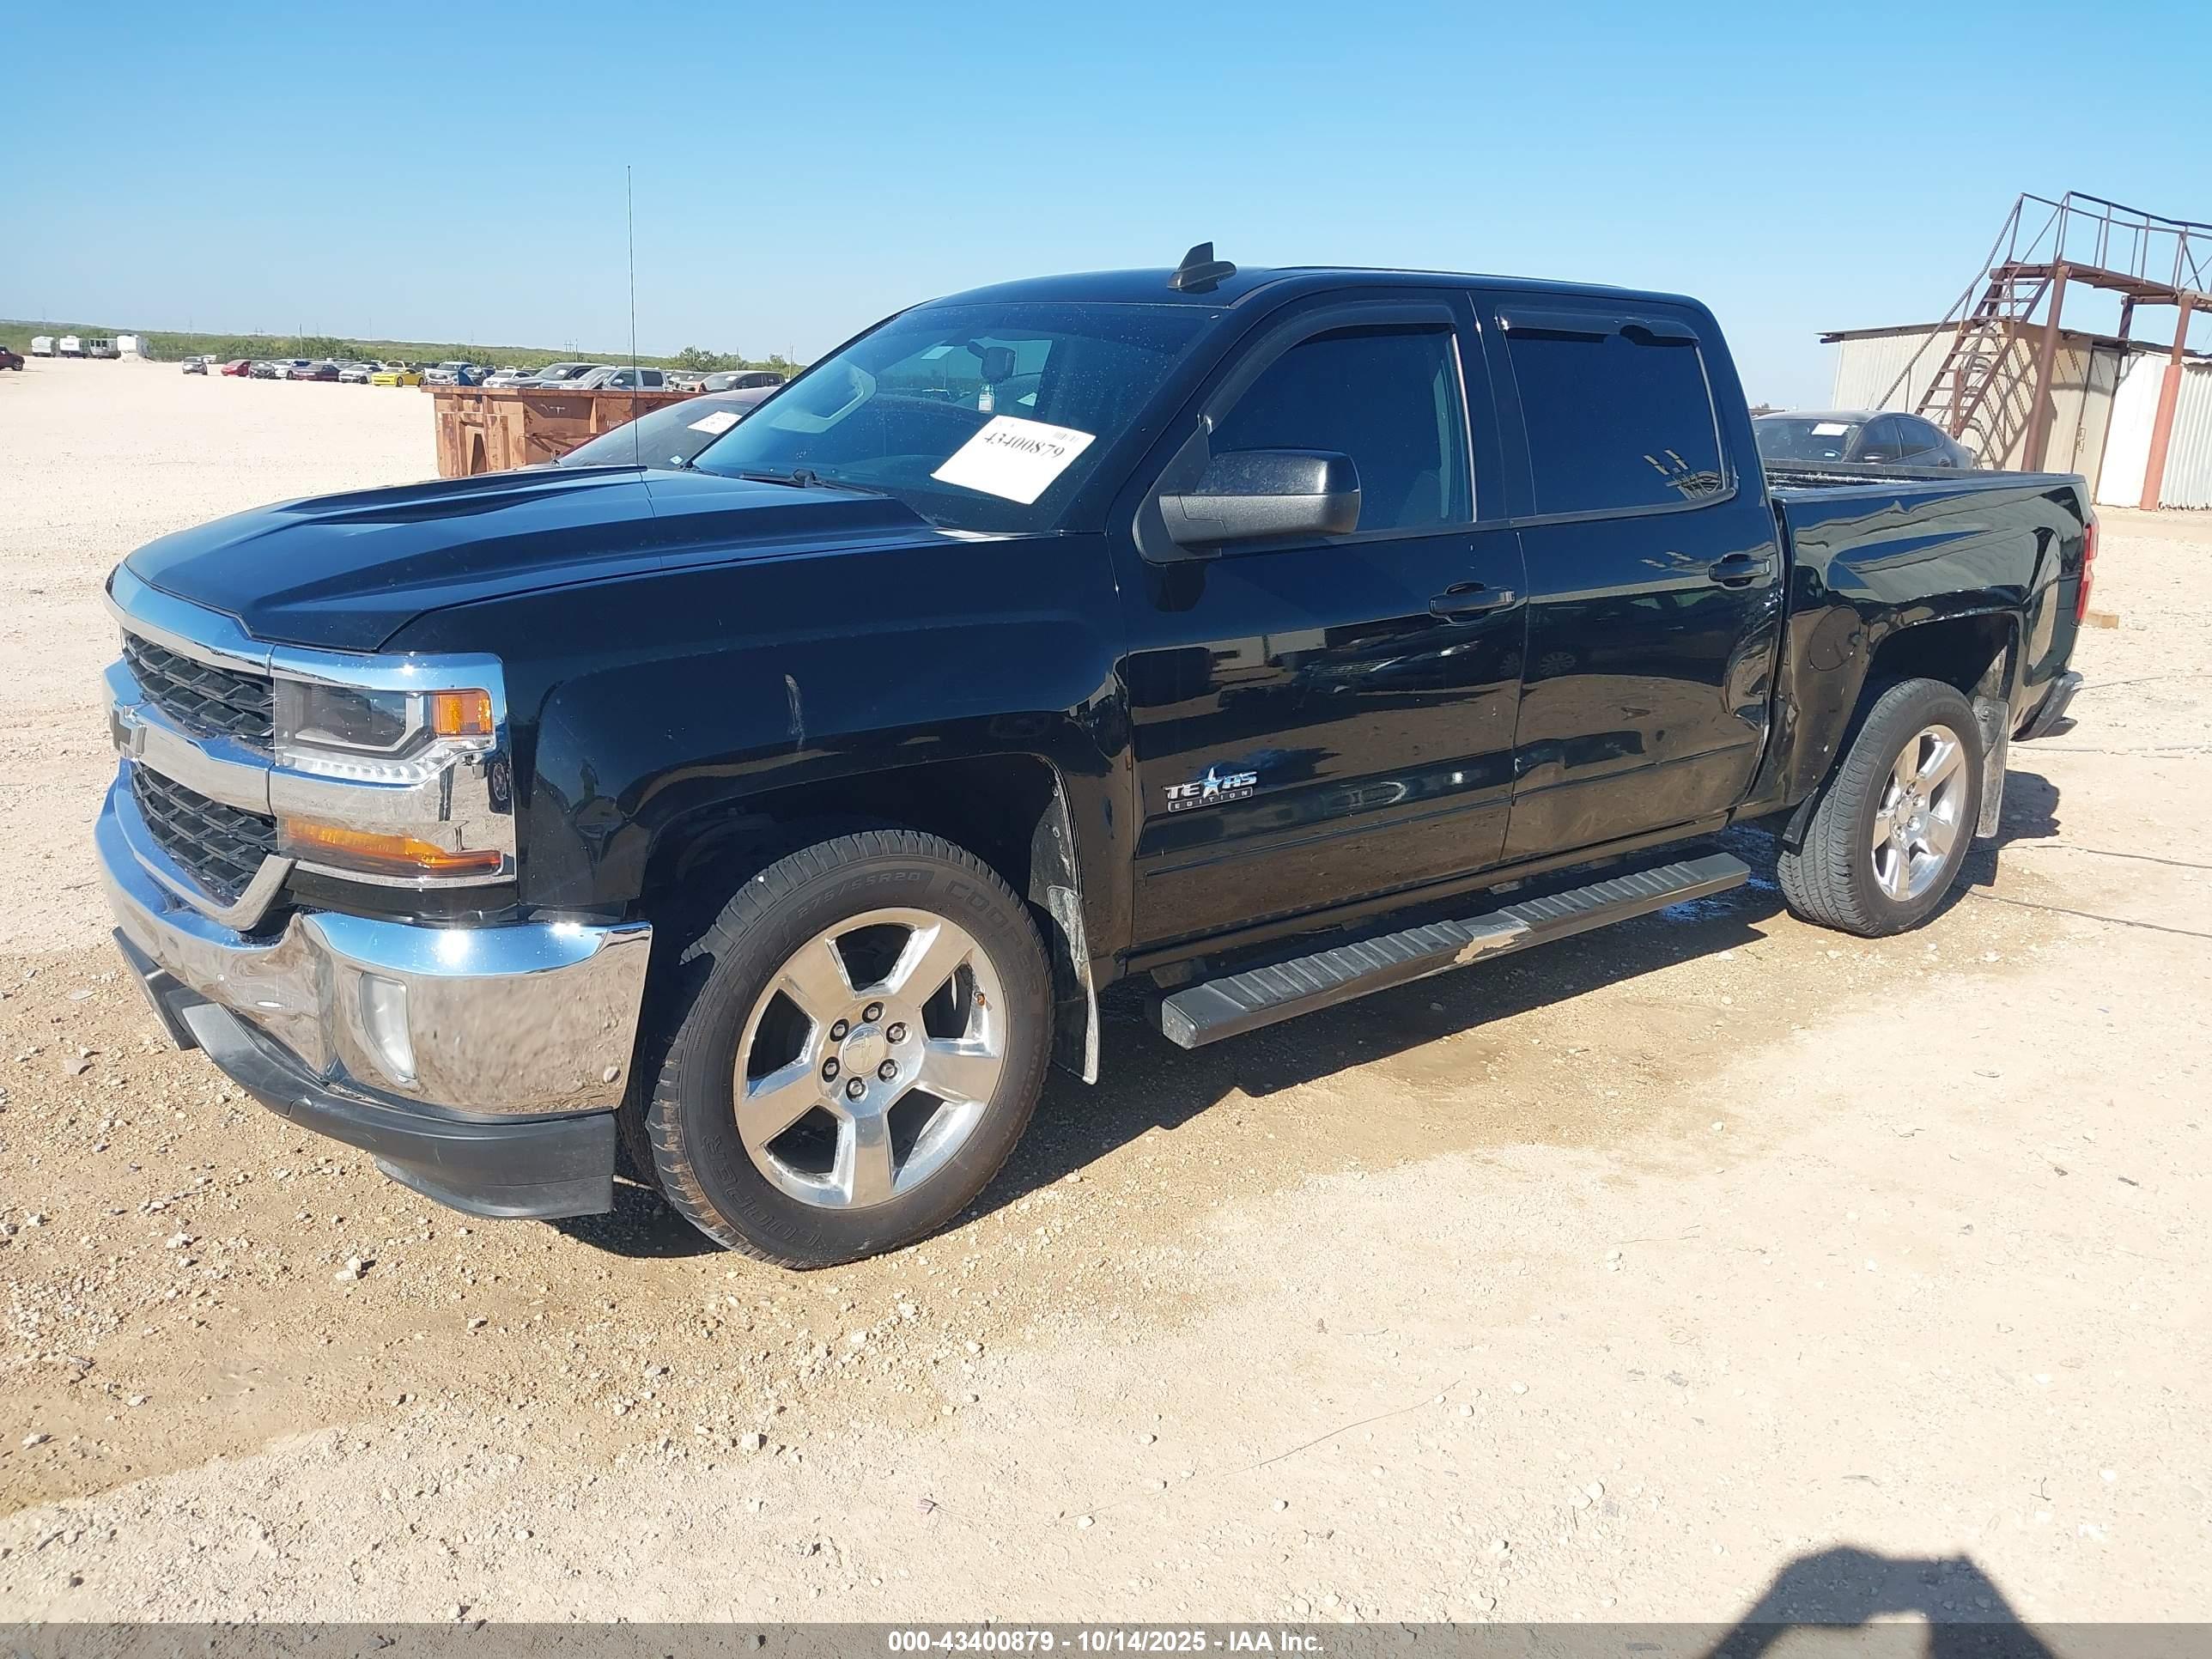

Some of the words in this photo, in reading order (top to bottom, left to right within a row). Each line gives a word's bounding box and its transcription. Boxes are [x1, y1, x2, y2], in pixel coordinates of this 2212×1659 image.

[984, 432, 1065, 459] 43400879
[1174, 790, 1249, 810] EDITION
[796, 871, 922, 921] 275/55R20
